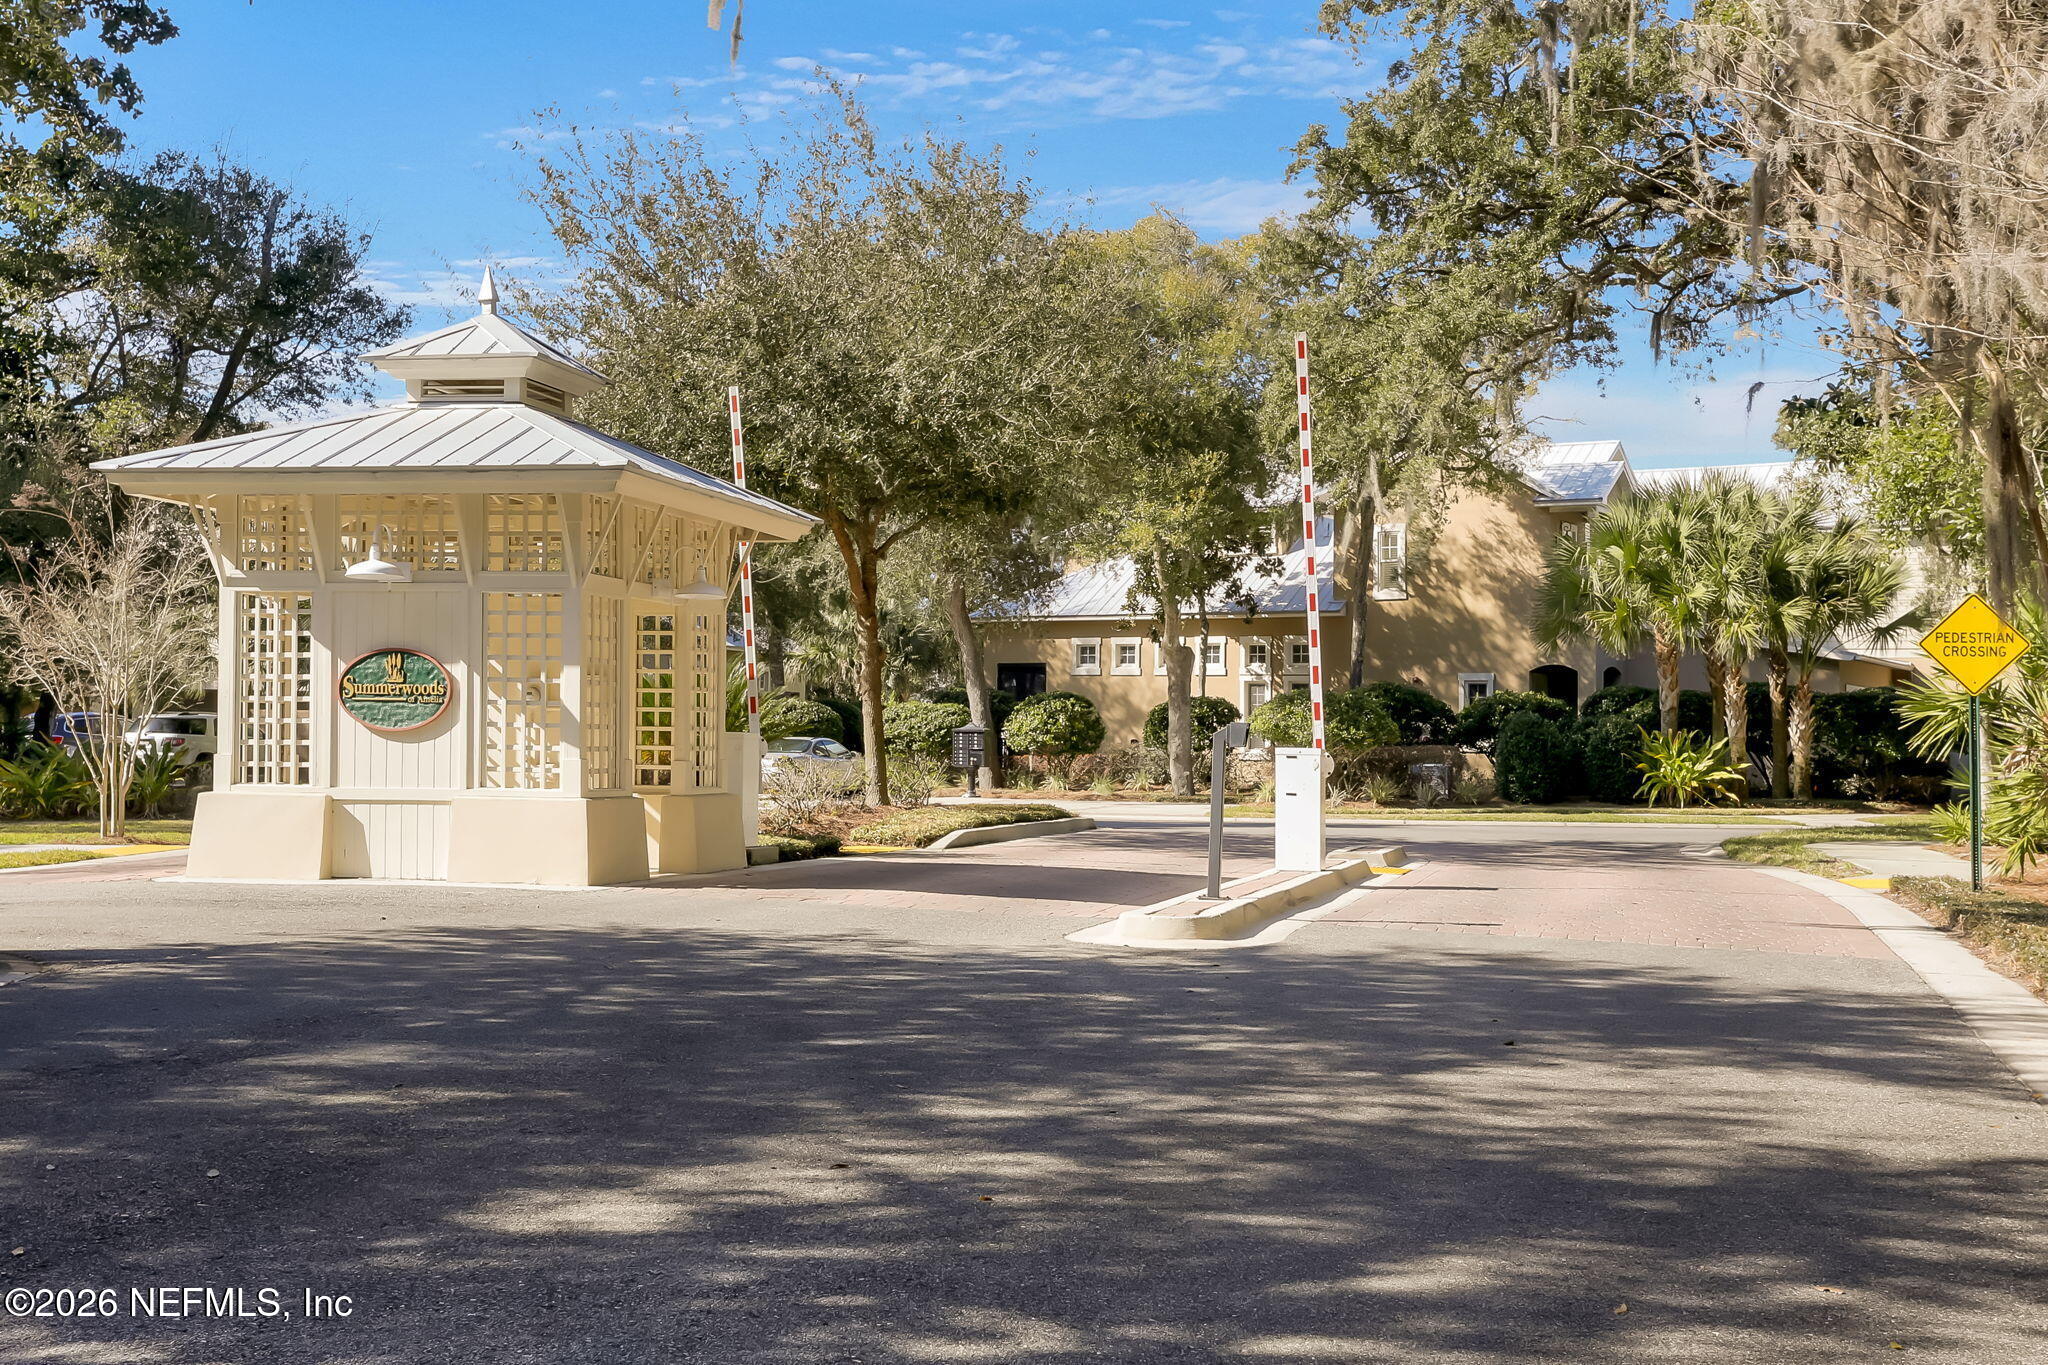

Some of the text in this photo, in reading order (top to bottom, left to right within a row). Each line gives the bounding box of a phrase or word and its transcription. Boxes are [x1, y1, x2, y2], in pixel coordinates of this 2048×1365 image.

[1935, 632, 2014, 643] PEDESTRIAN
[1943, 646, 2007, 657] CROSSING
[343, 676, 444, 698] Summerwoods
[407, 695, 443, 703] of Amelia
